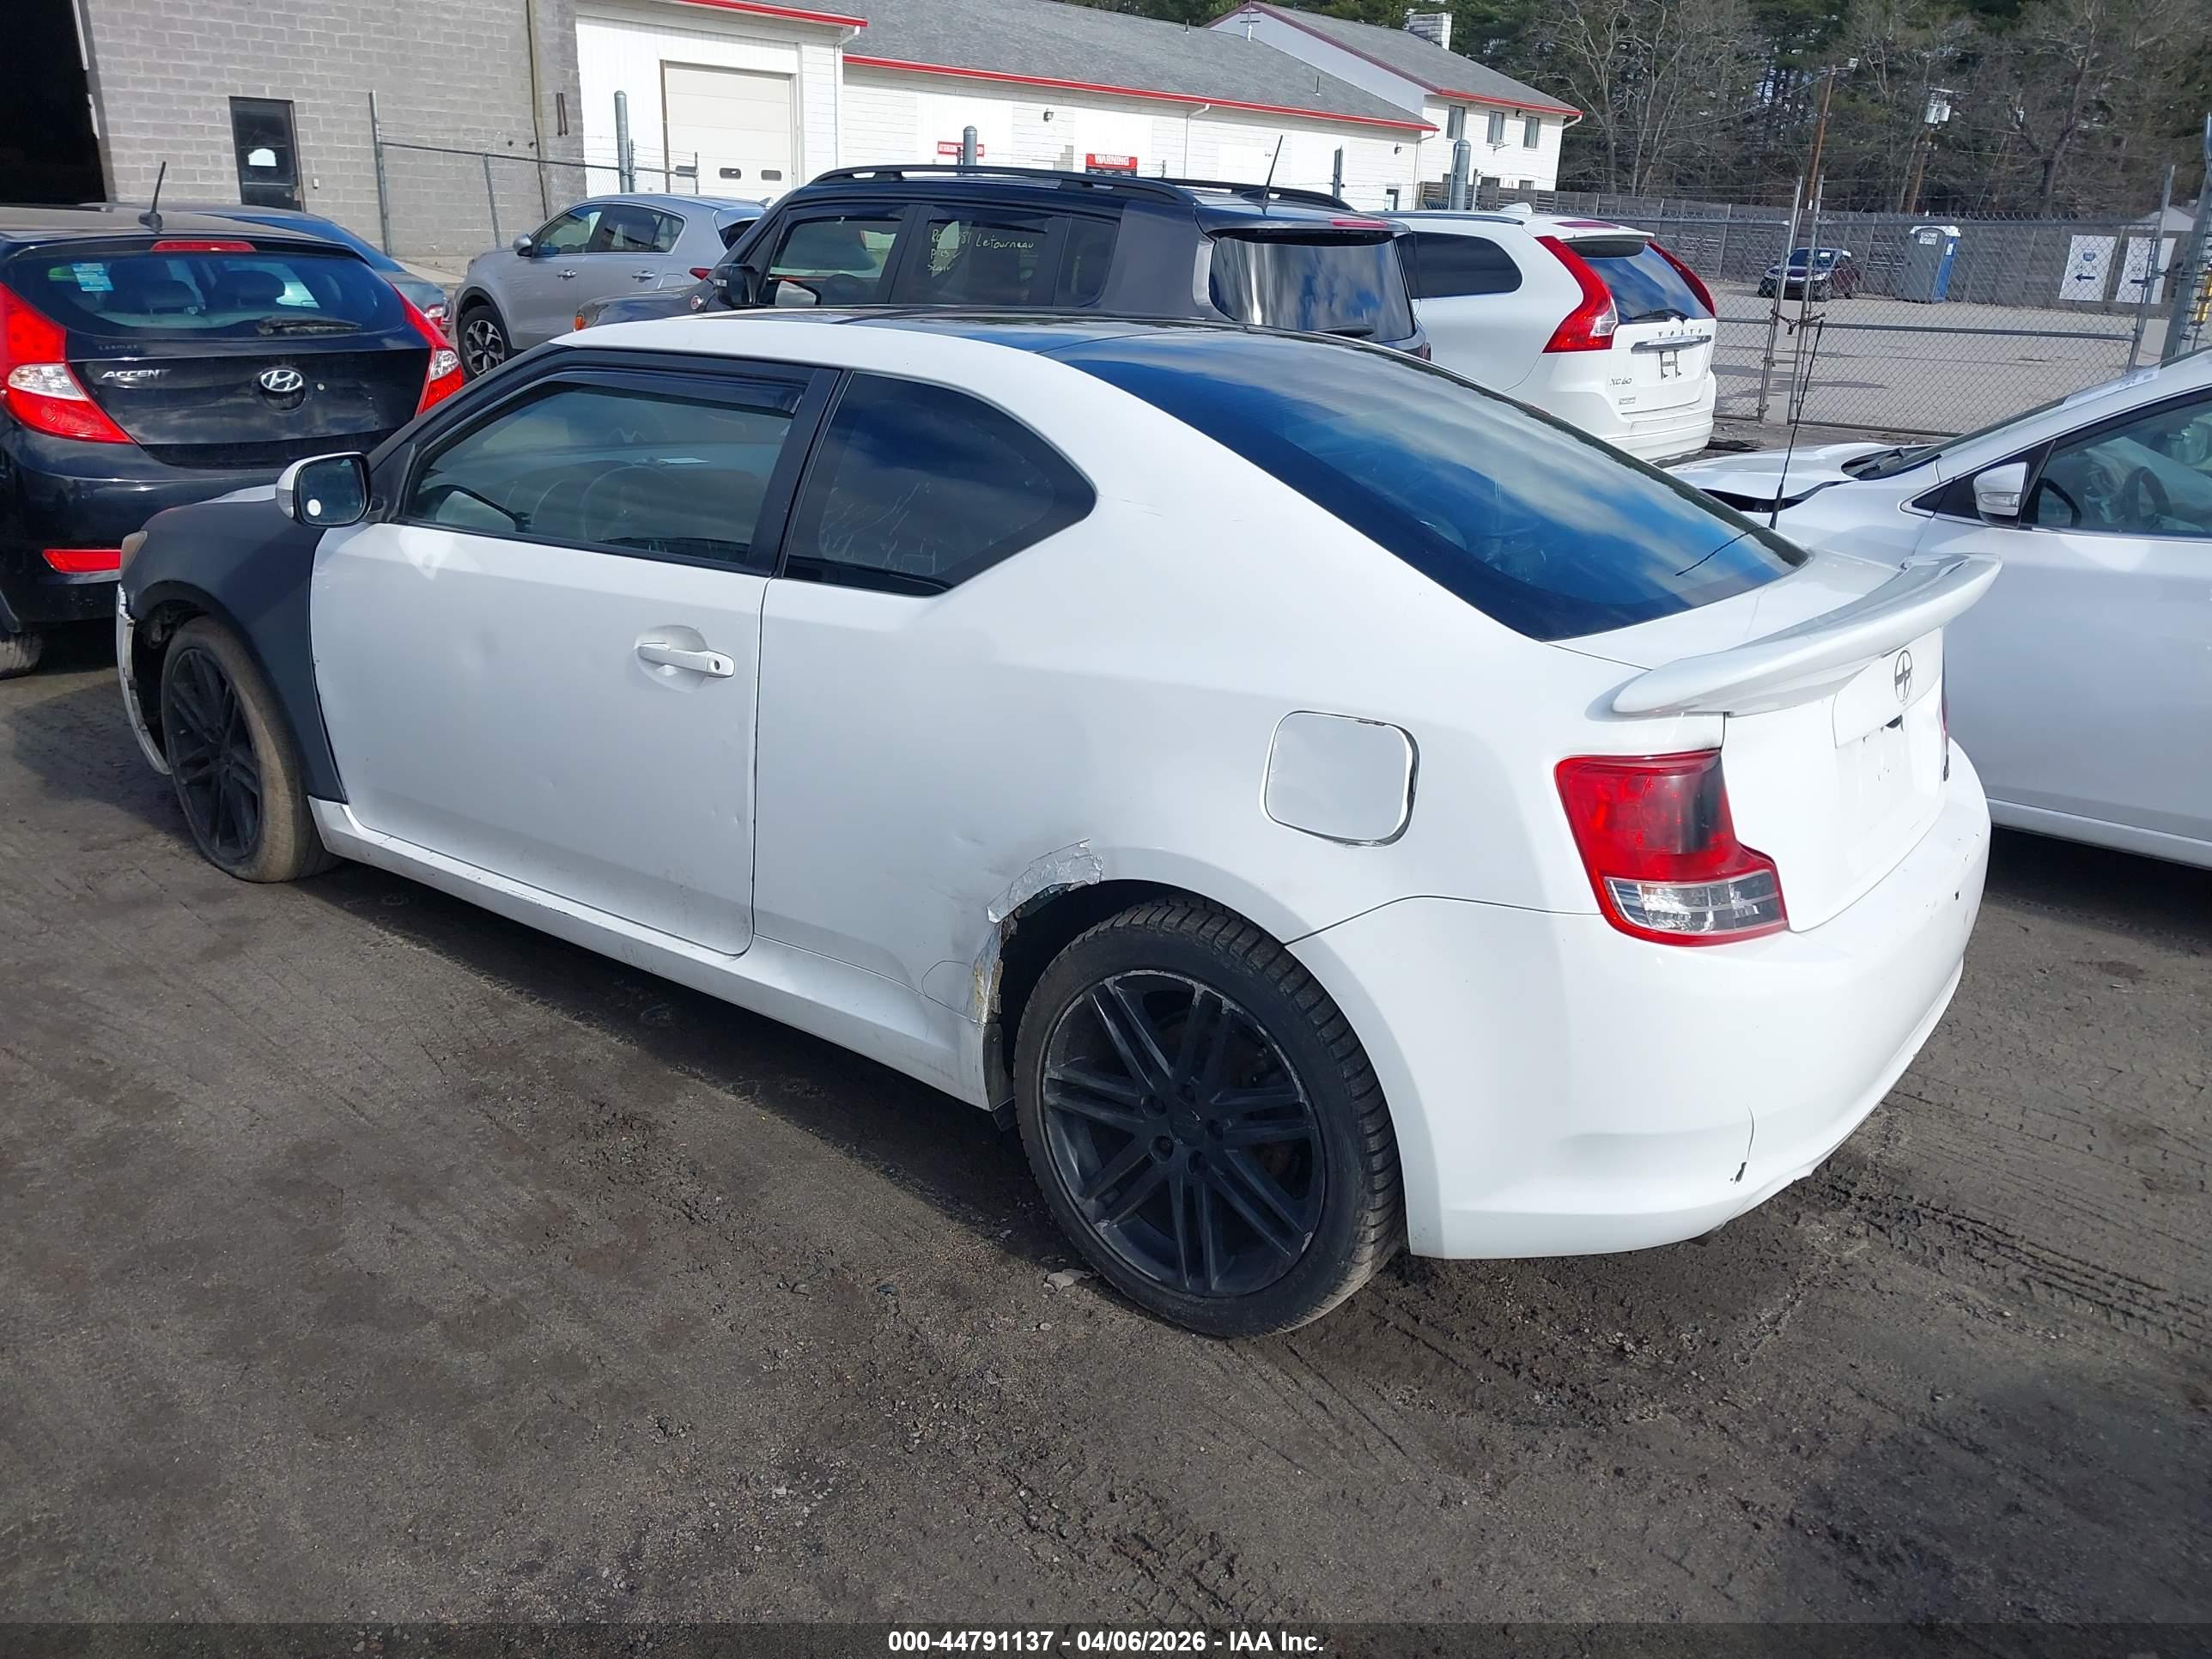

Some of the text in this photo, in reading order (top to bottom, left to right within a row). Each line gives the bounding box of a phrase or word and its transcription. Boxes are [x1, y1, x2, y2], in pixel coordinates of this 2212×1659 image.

[1095, 154, 1129, 167] WARNING
[1657, 328, 1703, 337] VOLVO
[101, 368, 172, 379] ACCENT
